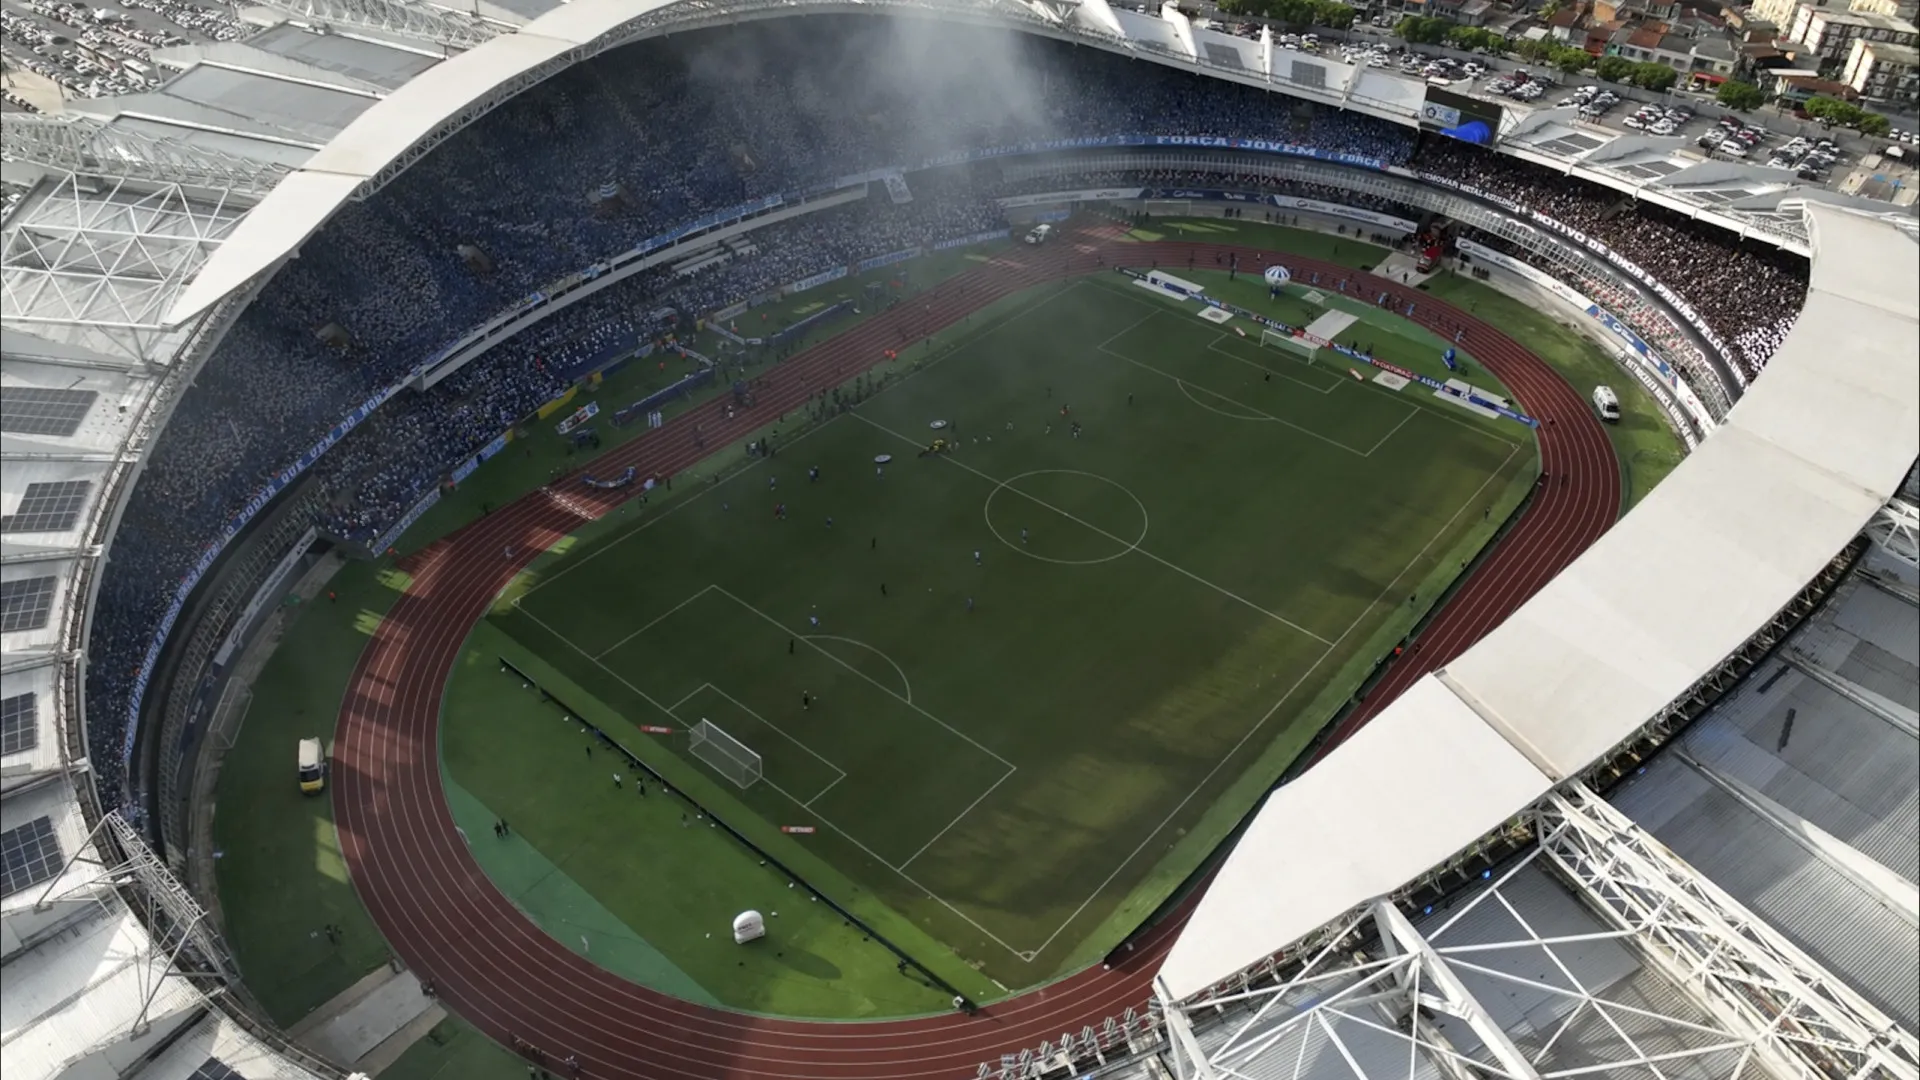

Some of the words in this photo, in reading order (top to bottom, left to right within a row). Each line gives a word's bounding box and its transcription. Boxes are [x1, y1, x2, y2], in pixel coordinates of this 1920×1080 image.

[1156, 134, 1227, 147] FORÇA
[1240, 139, 1316, 157] JOVEM
[1532, 210, 1585, 243] MOTIVO
[1586, 237, 1607, 255] DE
[1608, 249, 1645, 279] AMOR
[1645, 273, 1656, 289] E
[1697, 318, 1723, 350] PELO
[1719, 346, 1746, 386] CLUBE
[238, 485, 278, 524] PODER
[281, 462, 305, 485] QUE
[310, 436, 336, 460] VEM
[340, 415, 356, 433] DO
